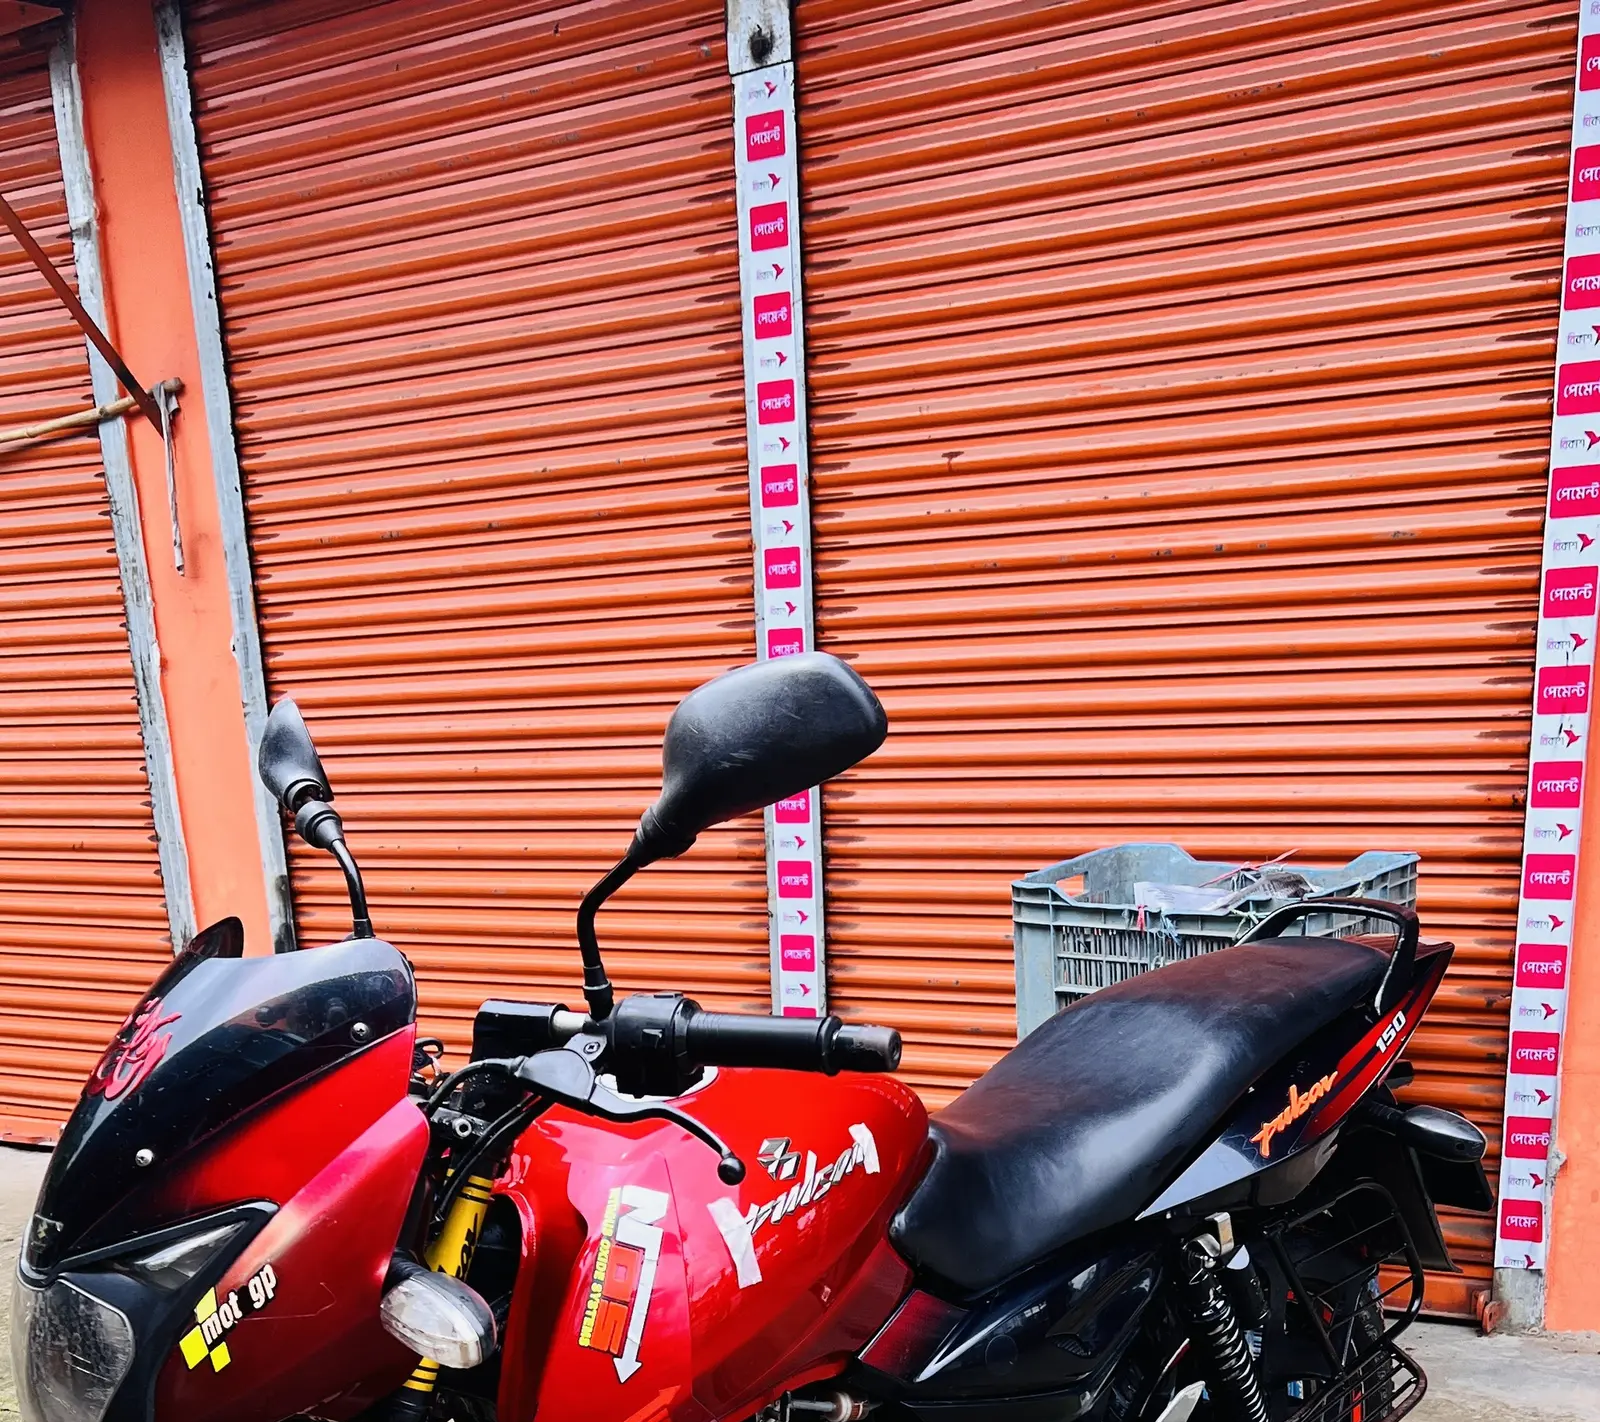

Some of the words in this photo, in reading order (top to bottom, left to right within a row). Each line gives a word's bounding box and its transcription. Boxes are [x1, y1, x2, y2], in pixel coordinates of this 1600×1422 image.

[1549, 583, 1594, 602] পেমেন্ট
[1543, 681, 1586, 699] পেমেন্ট
[1537, 776, 1579, 793] পেমেন্ট
[1529, 869, 1571, 885] পেমেন্ট
[1522, 959, 1563, 975] পেমেন্ট
[1375, 1010, 1406, 1054] 150
[1516, 1047, 1556, 1061] পেমেন্ট
[1510, 1132, 1550, 1147] পেমেন্ট
[593, 1238, 611, 1281] OXIDE
[590, 1185, 669, 1356] NOS
[248, 1263, 277, 1309] gp
[578, 1282, 603, 1347] SYSTEMS
